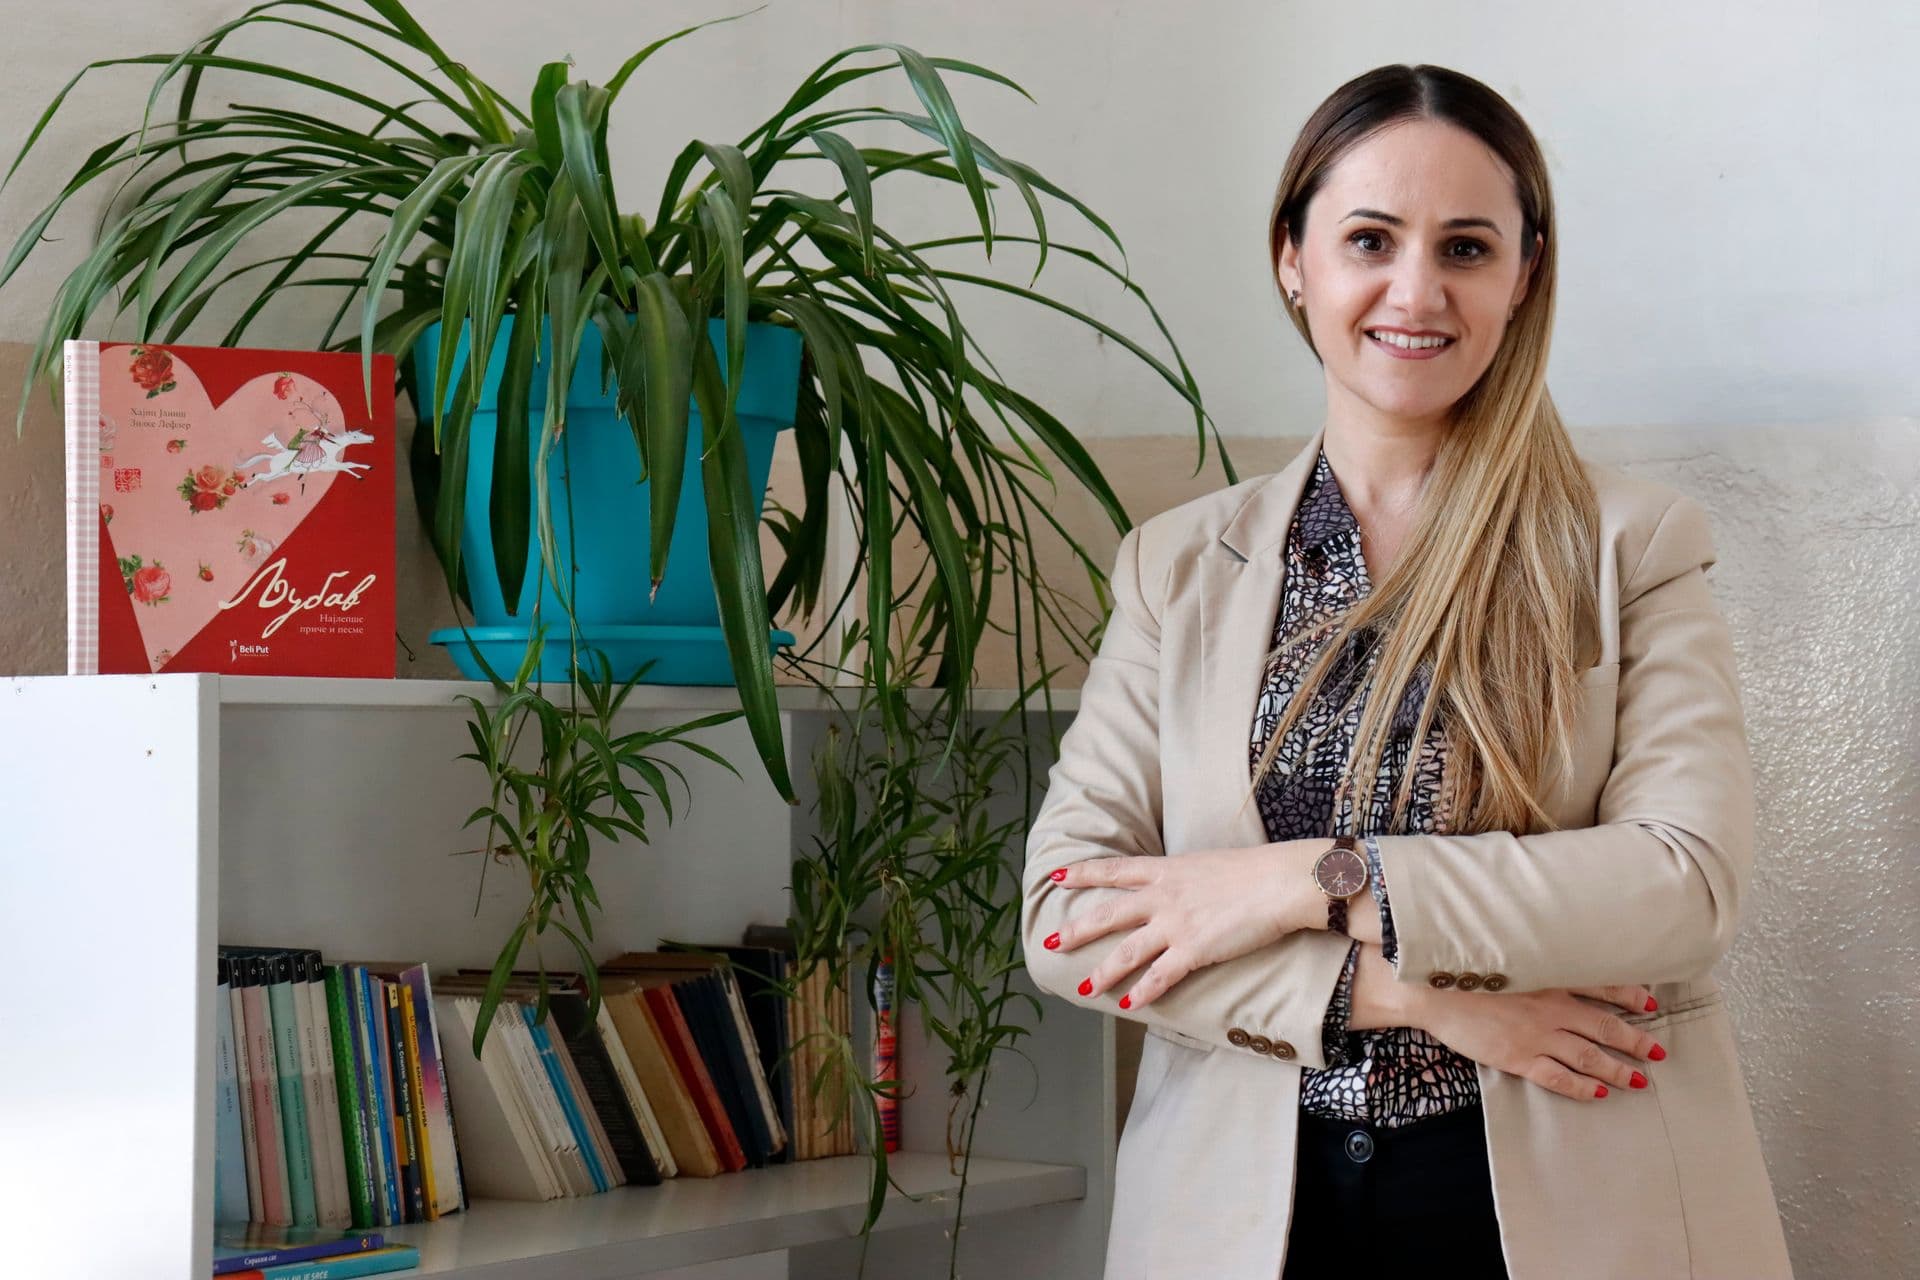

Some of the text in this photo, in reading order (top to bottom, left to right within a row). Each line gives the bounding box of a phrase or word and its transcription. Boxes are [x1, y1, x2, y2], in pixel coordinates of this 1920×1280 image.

[218, 557, 376, 639] Љубав
[319, 613, 364, 625] Најлепше
[299, 625, 364, 635] приче и песме
[239, 645, 269, 654] Beli Put
